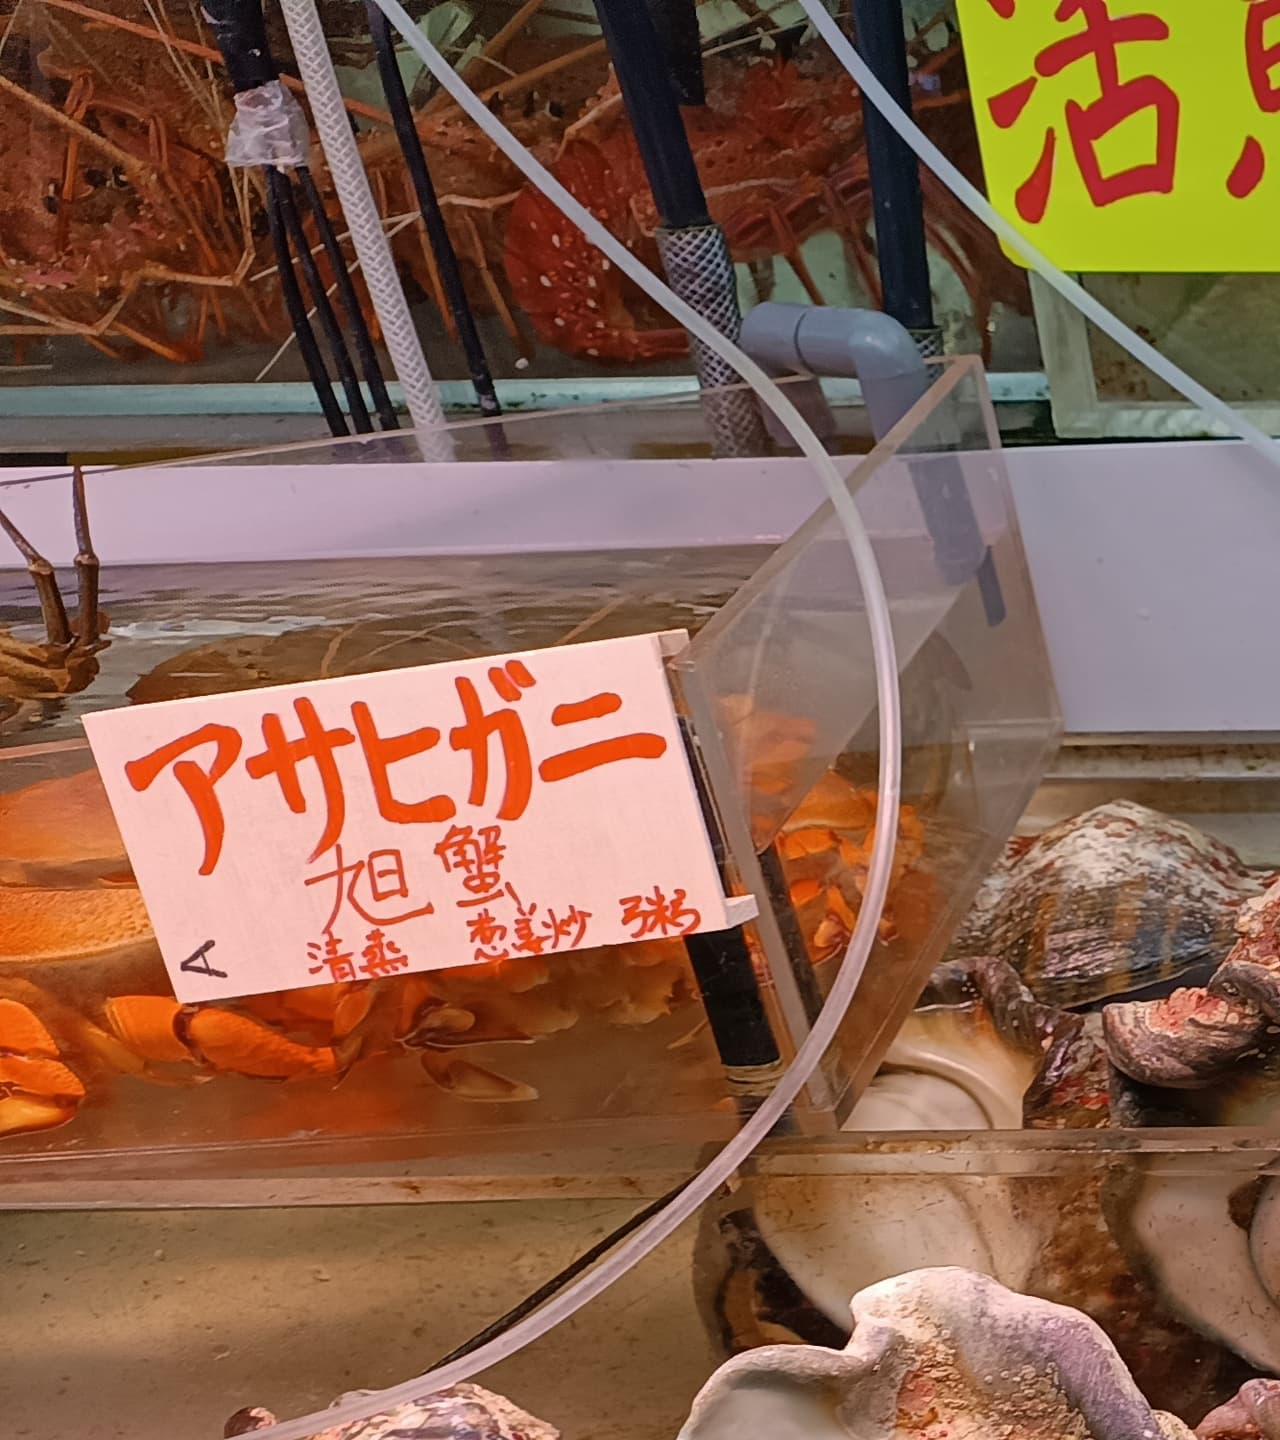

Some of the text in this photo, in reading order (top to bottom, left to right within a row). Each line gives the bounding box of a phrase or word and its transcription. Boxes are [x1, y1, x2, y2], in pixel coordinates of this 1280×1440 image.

[126, 660, 666, 877] アサヒガニ
[304, 824, 507, 932] 旭蟹
[307, 929, 408, 983] 清蒸
[620, 888, 701, 938] 粥
